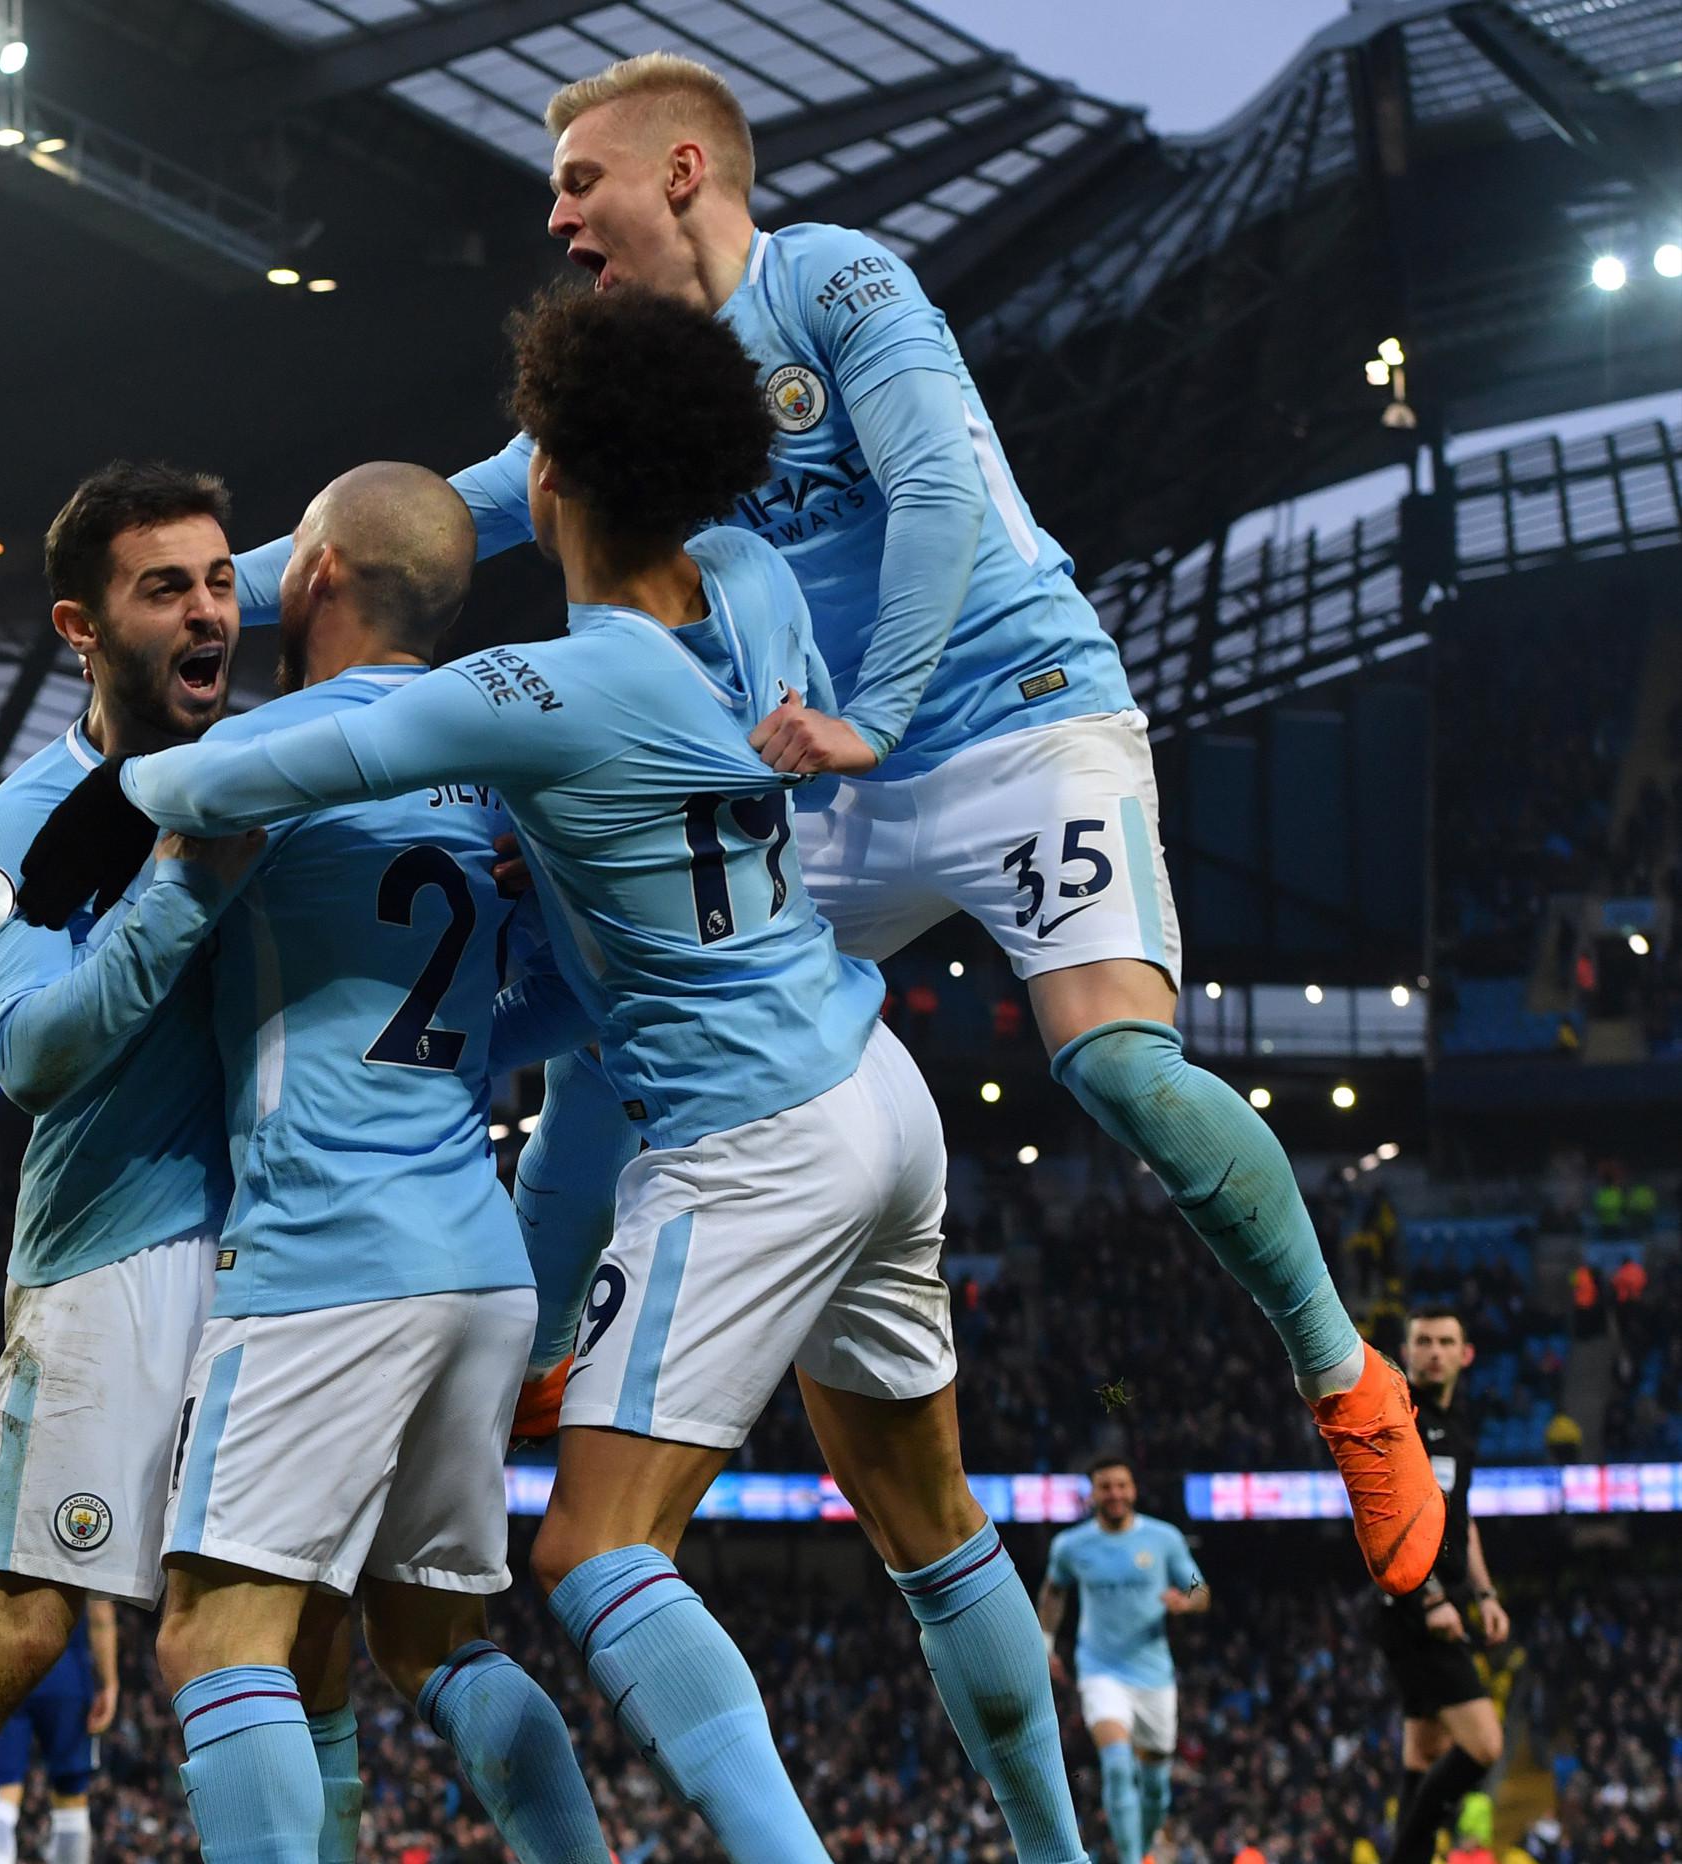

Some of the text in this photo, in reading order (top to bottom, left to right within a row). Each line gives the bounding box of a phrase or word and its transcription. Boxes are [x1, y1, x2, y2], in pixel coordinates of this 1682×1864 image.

[817, 256, 895, 311] NEXEN
[838, 279, 900, 315] TIRE
[465, 658, 521, 707] TIRE
[484, 648, 564, 713] NEXEN
[428, 783, 502, 812] SILV
[1002, 819, 1113, 928] 35
[573, 1264, 627, 1358] 9
[63, 1497, 108, 1519] MANCHESTER
[71, 1539, 88, 1547] CITY
